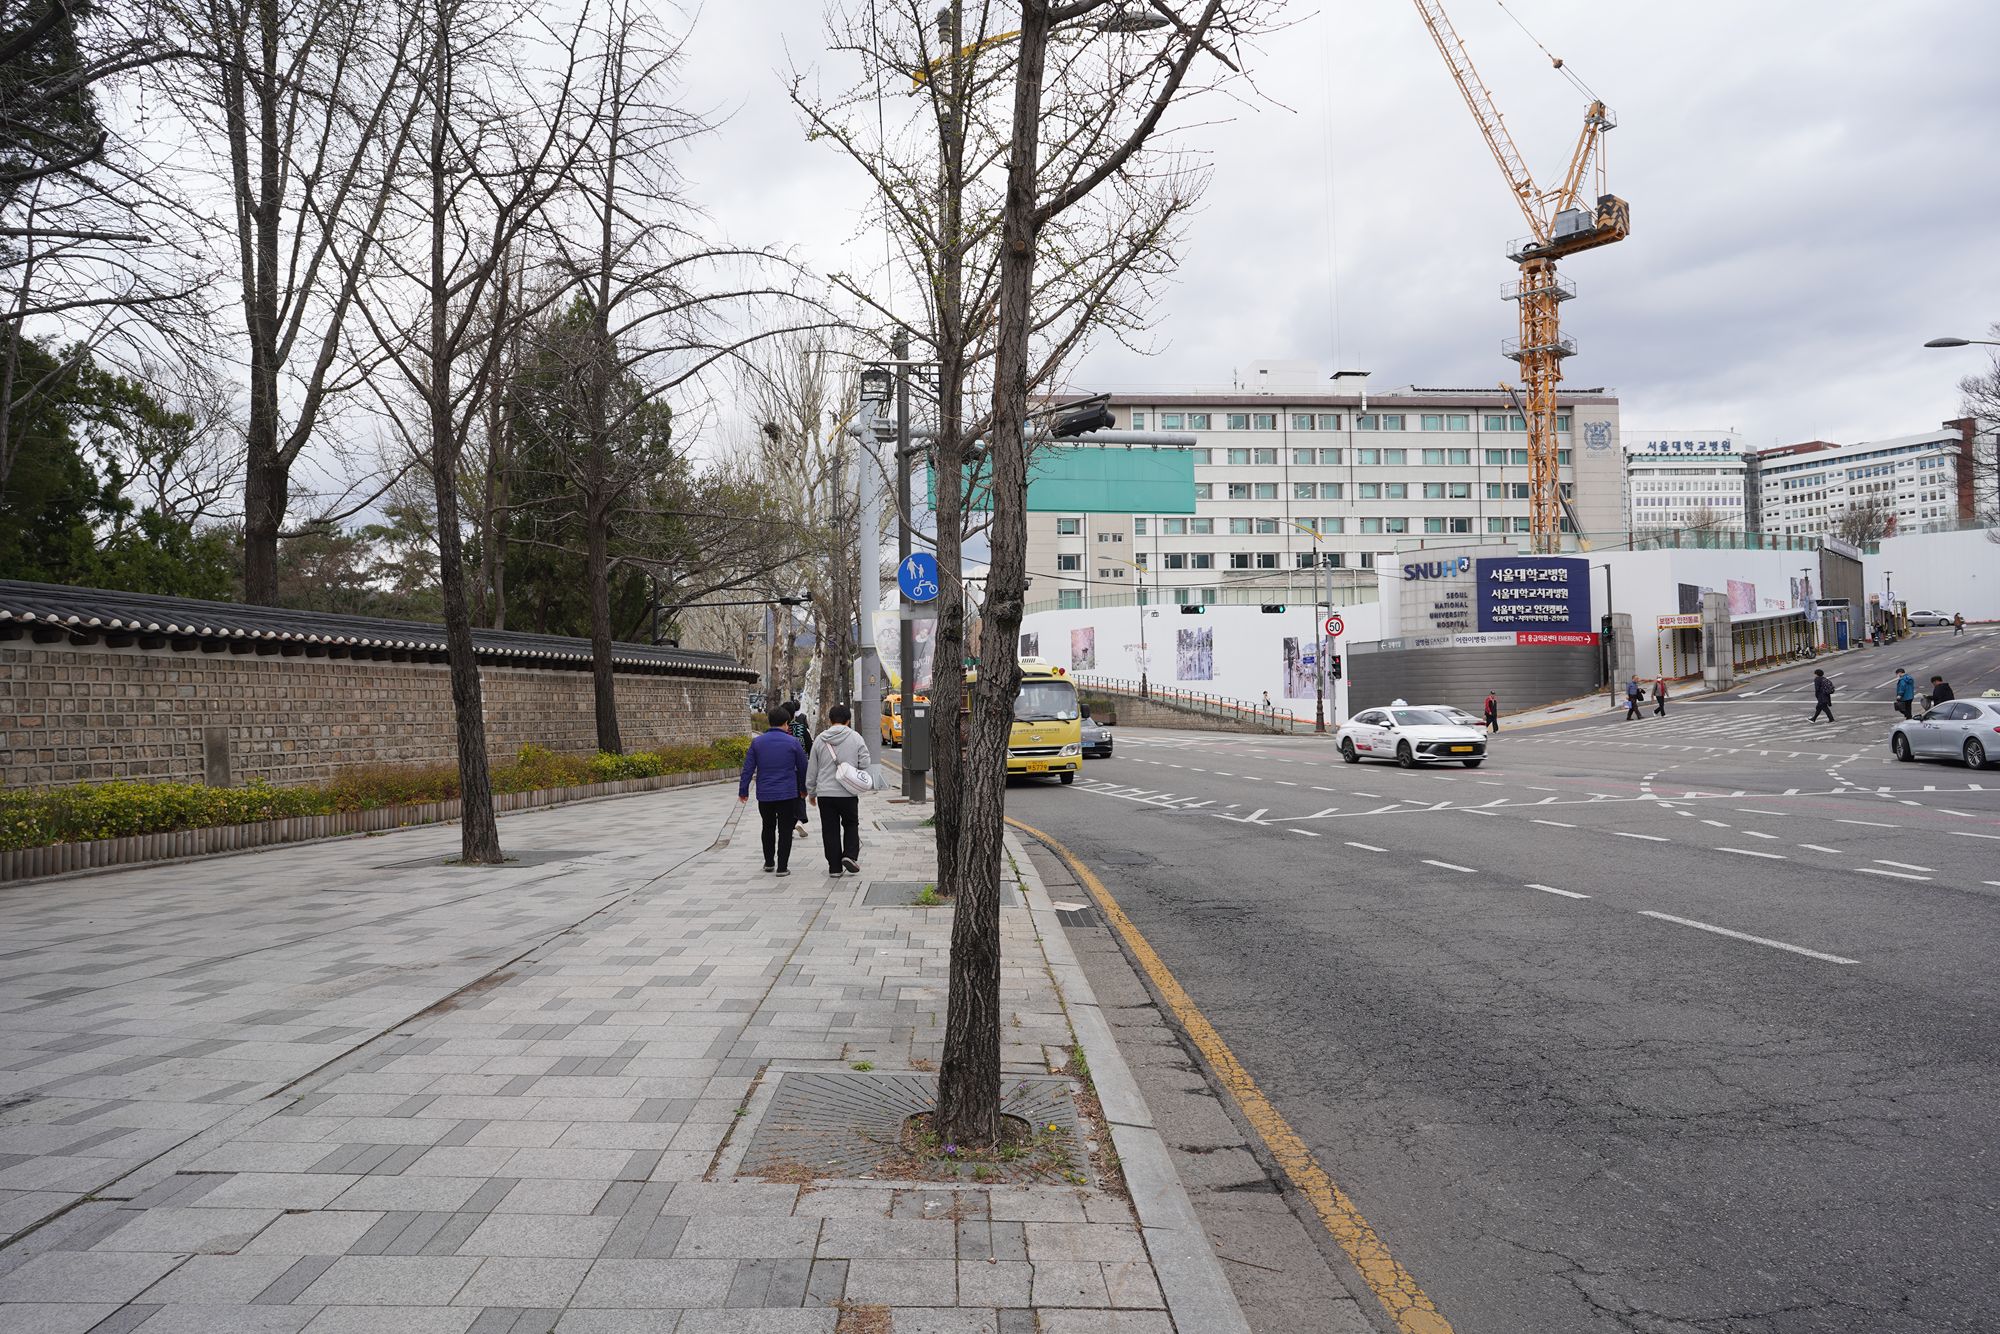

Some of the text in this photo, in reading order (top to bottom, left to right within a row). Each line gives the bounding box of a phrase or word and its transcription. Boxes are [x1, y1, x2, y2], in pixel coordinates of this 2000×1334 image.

[1647, 440, 1731, 452] 서울대학교병원
[1403, 560, 1457, 581] SNUH
[1490, 568, 1568, 582] 서울대학교병원
[1491, 588, 1569, 599] 서울대학교치과병원
[1429, 611, 1469, 619] UNIVERSITY
[1492, 605, 1532, 615] 서울대학교
[1659, 616, 1675, 625] 보행자
[1329, 622, 1341, 632] 50
[1456, 635, 1487, 644] 어린이병원
